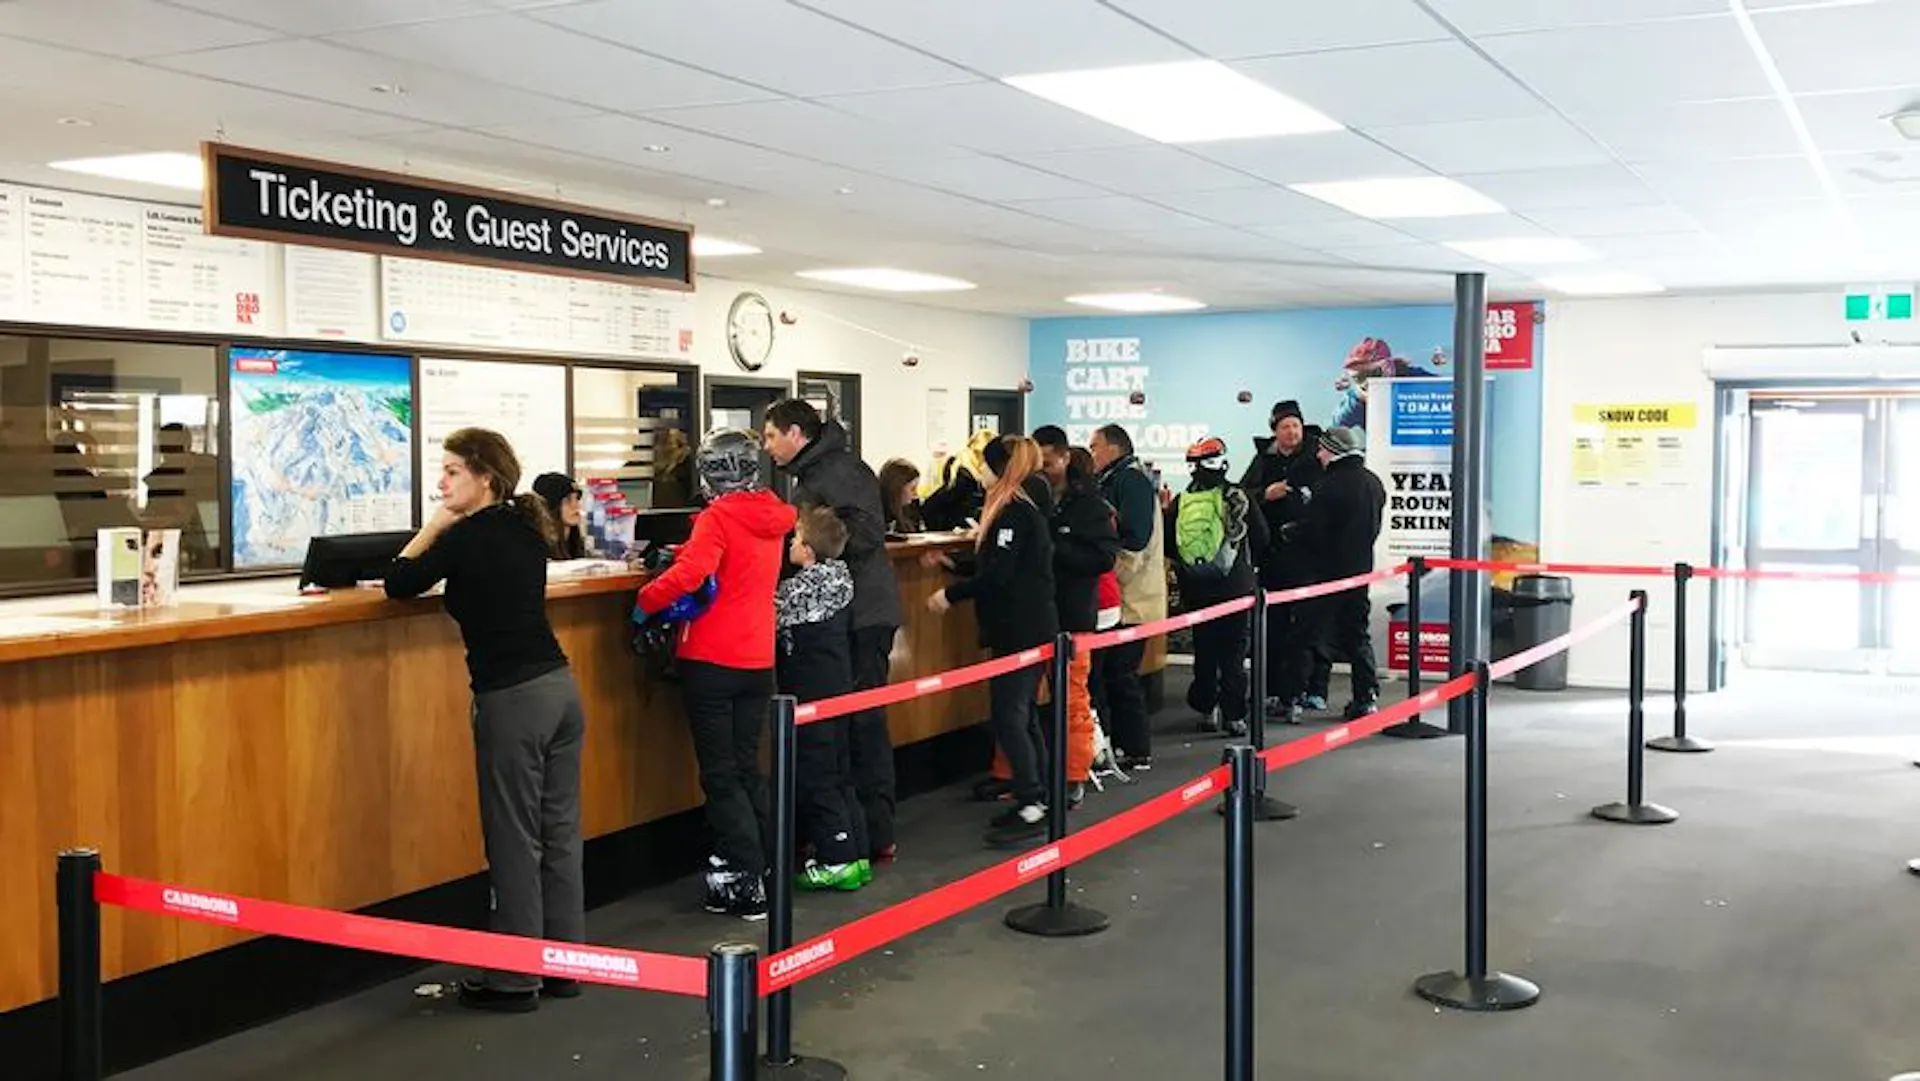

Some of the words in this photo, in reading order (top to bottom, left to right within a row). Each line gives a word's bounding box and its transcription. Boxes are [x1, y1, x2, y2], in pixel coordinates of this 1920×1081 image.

[249, 168, 418, 245] Ticketing
[429, 198, 455, 240] &
[465, 204, 553, 254] Guest
[560, 219, 670, 270] Services
[1486, 309, 1516, 323] AR
[1066, 338, 1140, 362] BIKE
[1066, 366, 1149, 391] CART
[1398, 402, 1452, 412] TOMAM
[1599, 410, 1635, 422] SNOW
[1638, 409, 1669, 422] CODE
[1391, 473, 1452, 491] YEA
[1391, 496, 1450, 510] ROUN
[1391, 516, 1450, 530] SKIIN
[163, 888, 238, 915] CARDRONA
[543, 946, 638, 974] CARDRONA
[769, 938, 834, 977] CARDRONA
